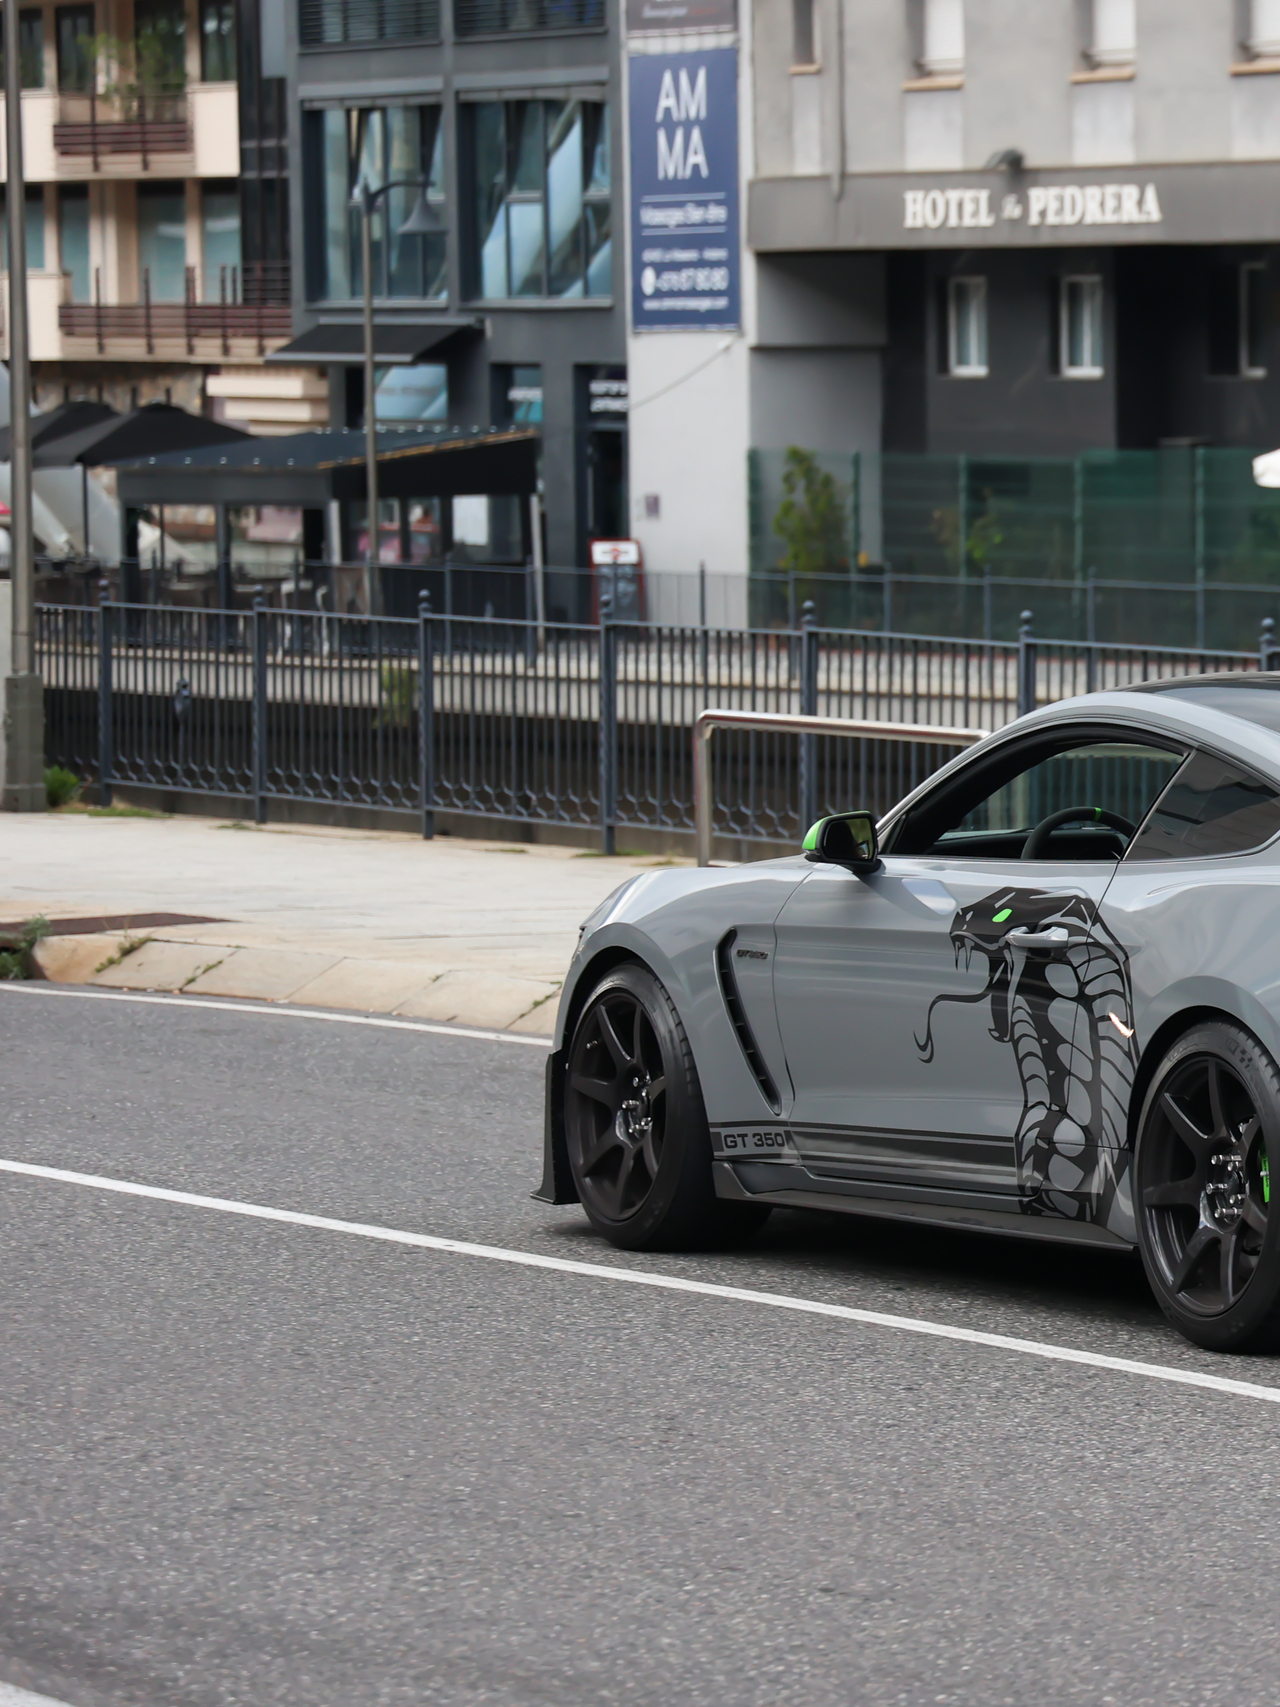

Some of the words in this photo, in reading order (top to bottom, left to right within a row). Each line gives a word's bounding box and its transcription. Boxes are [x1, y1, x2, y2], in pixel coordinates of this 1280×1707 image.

[655, 65, 707, 123] AM
[657, 124, 709, 181] MA
[903, 189, 996, 229] HOTEL
[1027, 183, 1163, 226] PEDRERA
[723, 1133, 748, 1149] GT
[752, 1132, 785, 1148] 350
